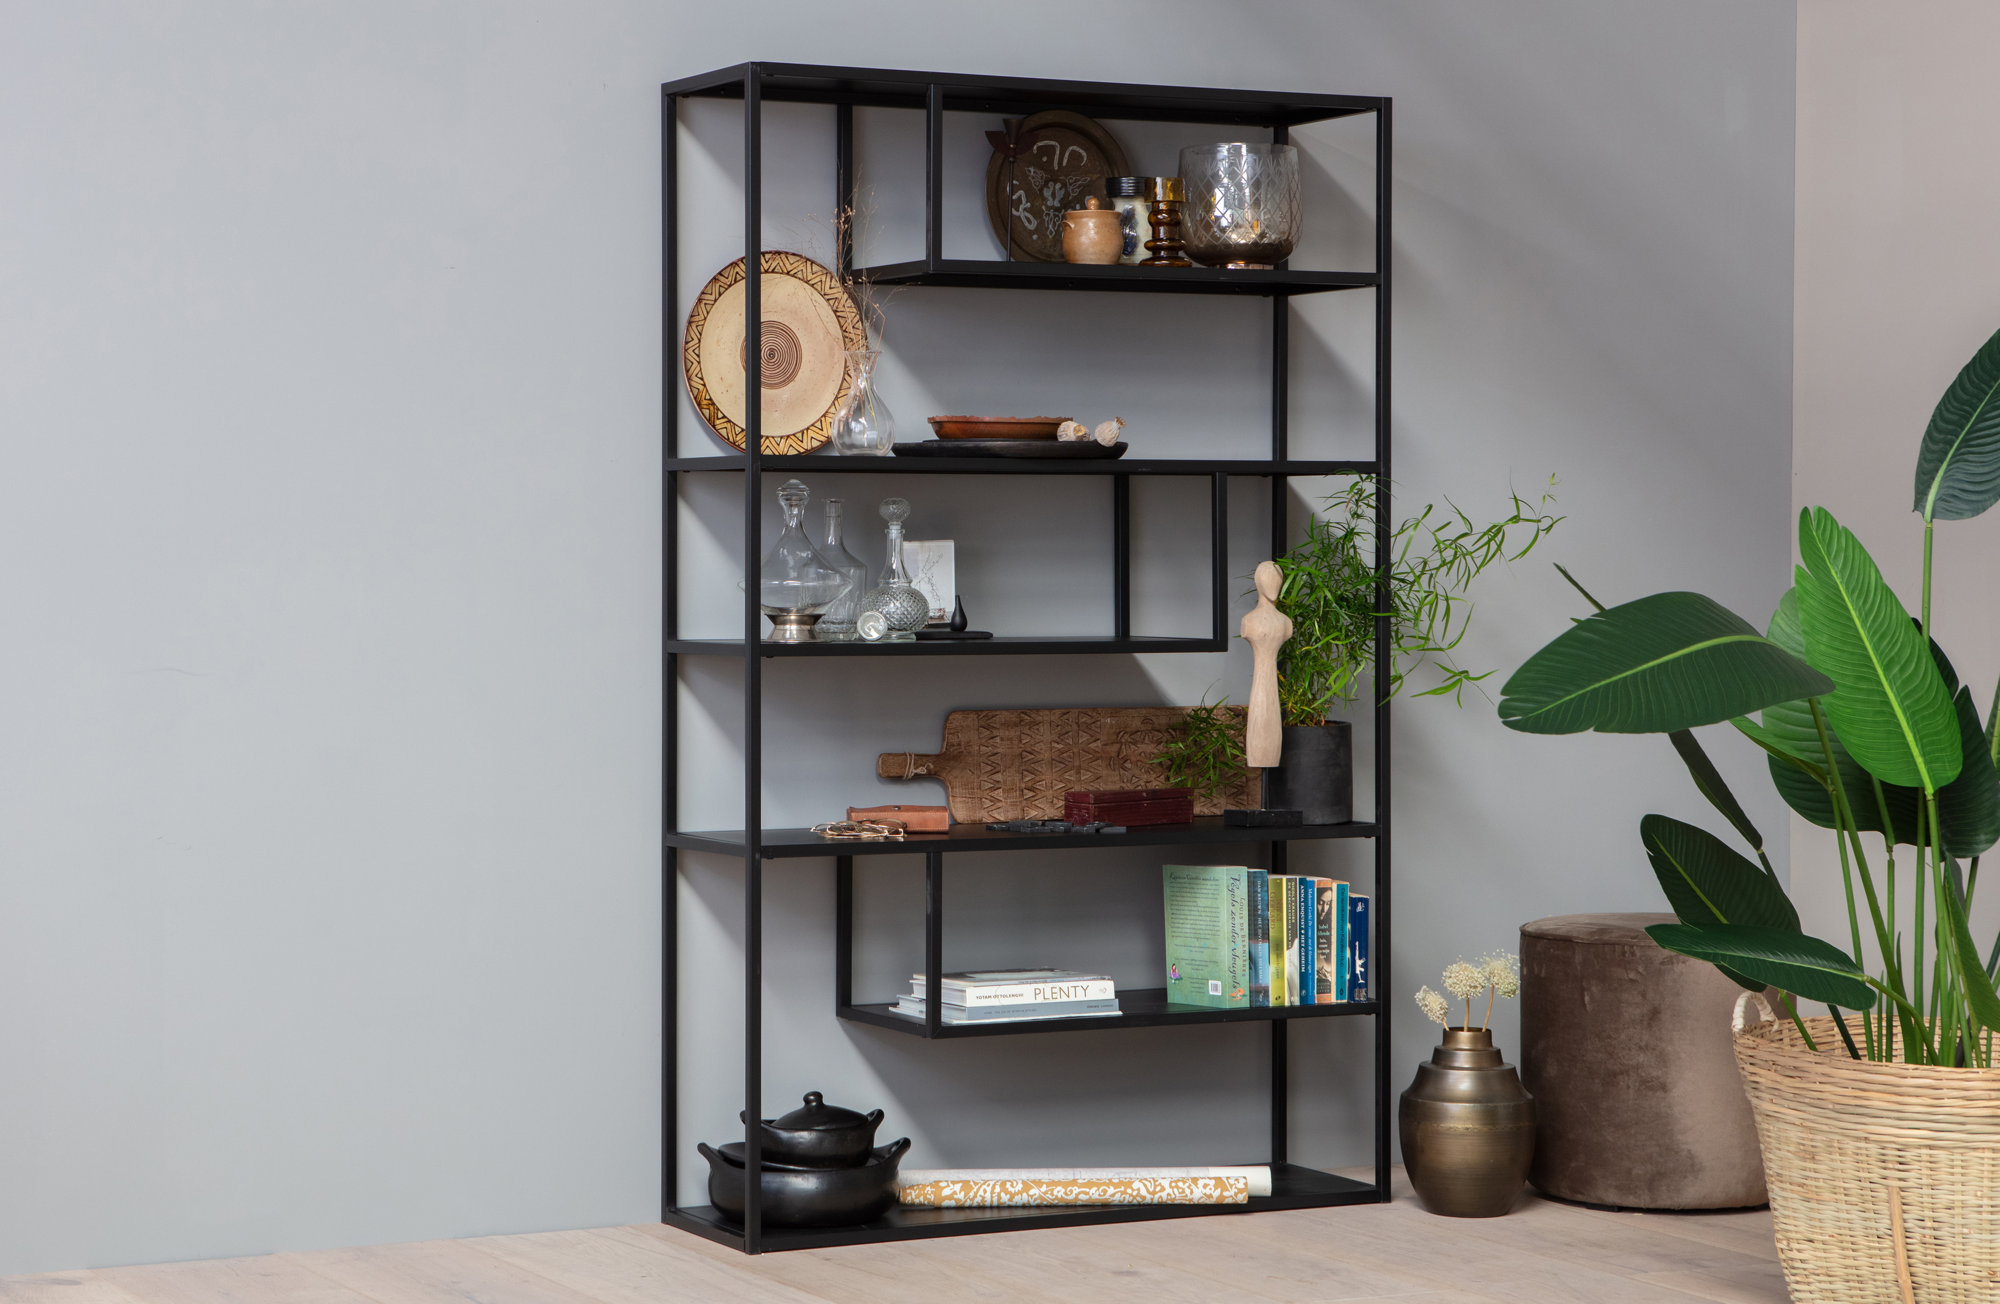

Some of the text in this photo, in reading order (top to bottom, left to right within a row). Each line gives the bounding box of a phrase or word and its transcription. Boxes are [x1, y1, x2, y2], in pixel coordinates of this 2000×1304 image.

[1287, 881, 1292, 889] DE
[1340, 888, 1345, 896] De
[1227, 874, 1242, 989] Vogels zonder vleugels
[1240, 922, 1245, 932] DE
[1034, 984, 1090, 1001] PLENTY
